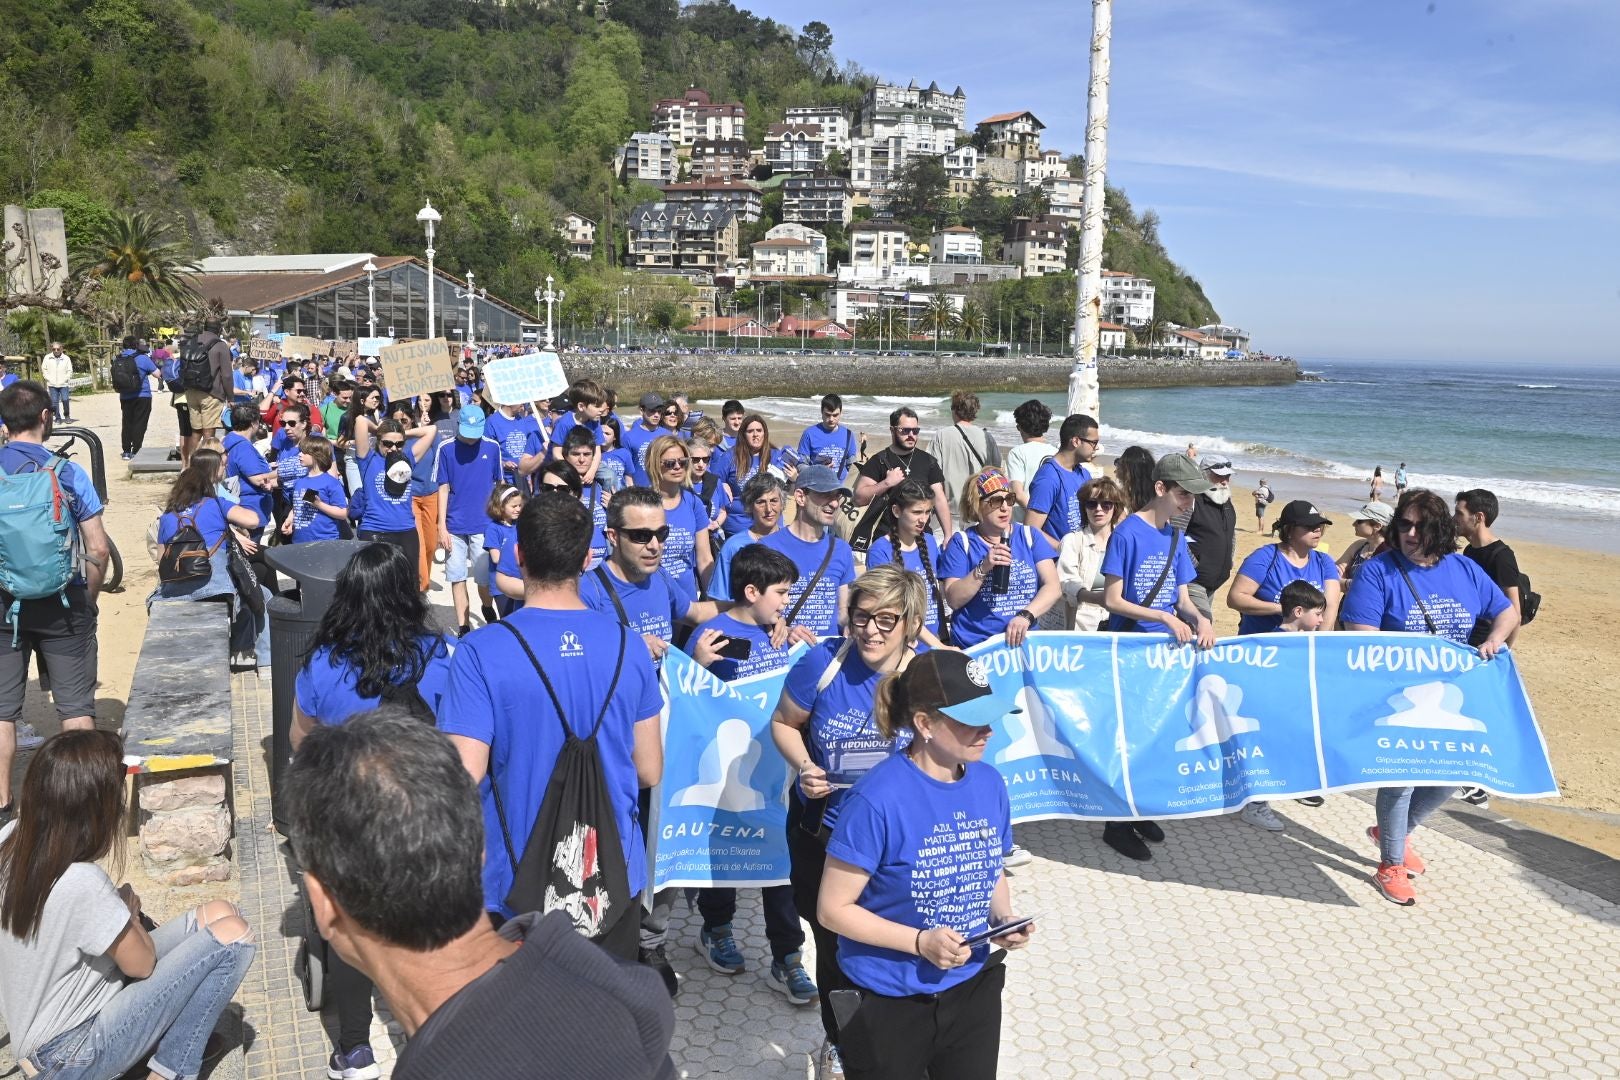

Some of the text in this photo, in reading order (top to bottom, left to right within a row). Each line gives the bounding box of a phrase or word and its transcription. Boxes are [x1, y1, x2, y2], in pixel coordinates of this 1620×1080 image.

[384, 342, 447, 363] AUTISMOA
[396, 362, 432, 381] EZ DA
[391, 372, 454, 398] SENDATZEN
[1347, 644, 1475, 672] URDINDU
[847, 707, 867, 719] AZUL
[828, 719, 853, 731] URDIN
[1377, 737, 1493, 756] GAUTENA
[1375, 756, 1427, 764] Gipuzkoako
[1428, 758, 1464, 766] Autismo
[953, 811, 966, 820] UN
[662, 822, 766, 840] GAUTENA
[933, 818, 988, 834] AZUL MUCHOS
[924, 833, 956, 846] MATICES
[918, 845, 946, 857] URDIN
[949, 842, 972, 852] ANITZ
[974, 841, 986, 850] UN
[731, 862, 741, 870] de
[742, 862, 773, 871] Autismo
[916, 850, 986, 868] MUCHOS MATICES
[912, 869, 931, 878] BAT
[934, 865, 957, 878] URDIN
[960, 861, 983, 872] ANITZ
[984, 859, 995, 868] UN
[911, 878, 950, 889] MUCHOS
[955, 871, 988, 884] MATICES
[911, 880, 995, 899] BAT URDIN ANITZ UN
[914, 896, 949, 907] MUCHOS
[953, 892, 984, 902] MATICES
[917, 906, 935, 916] BAT
[966, 900, 990, 910] ANITZ
[940, 913, 970, 924] MUCHOS
[968, 917, 987, 929] URDIN
